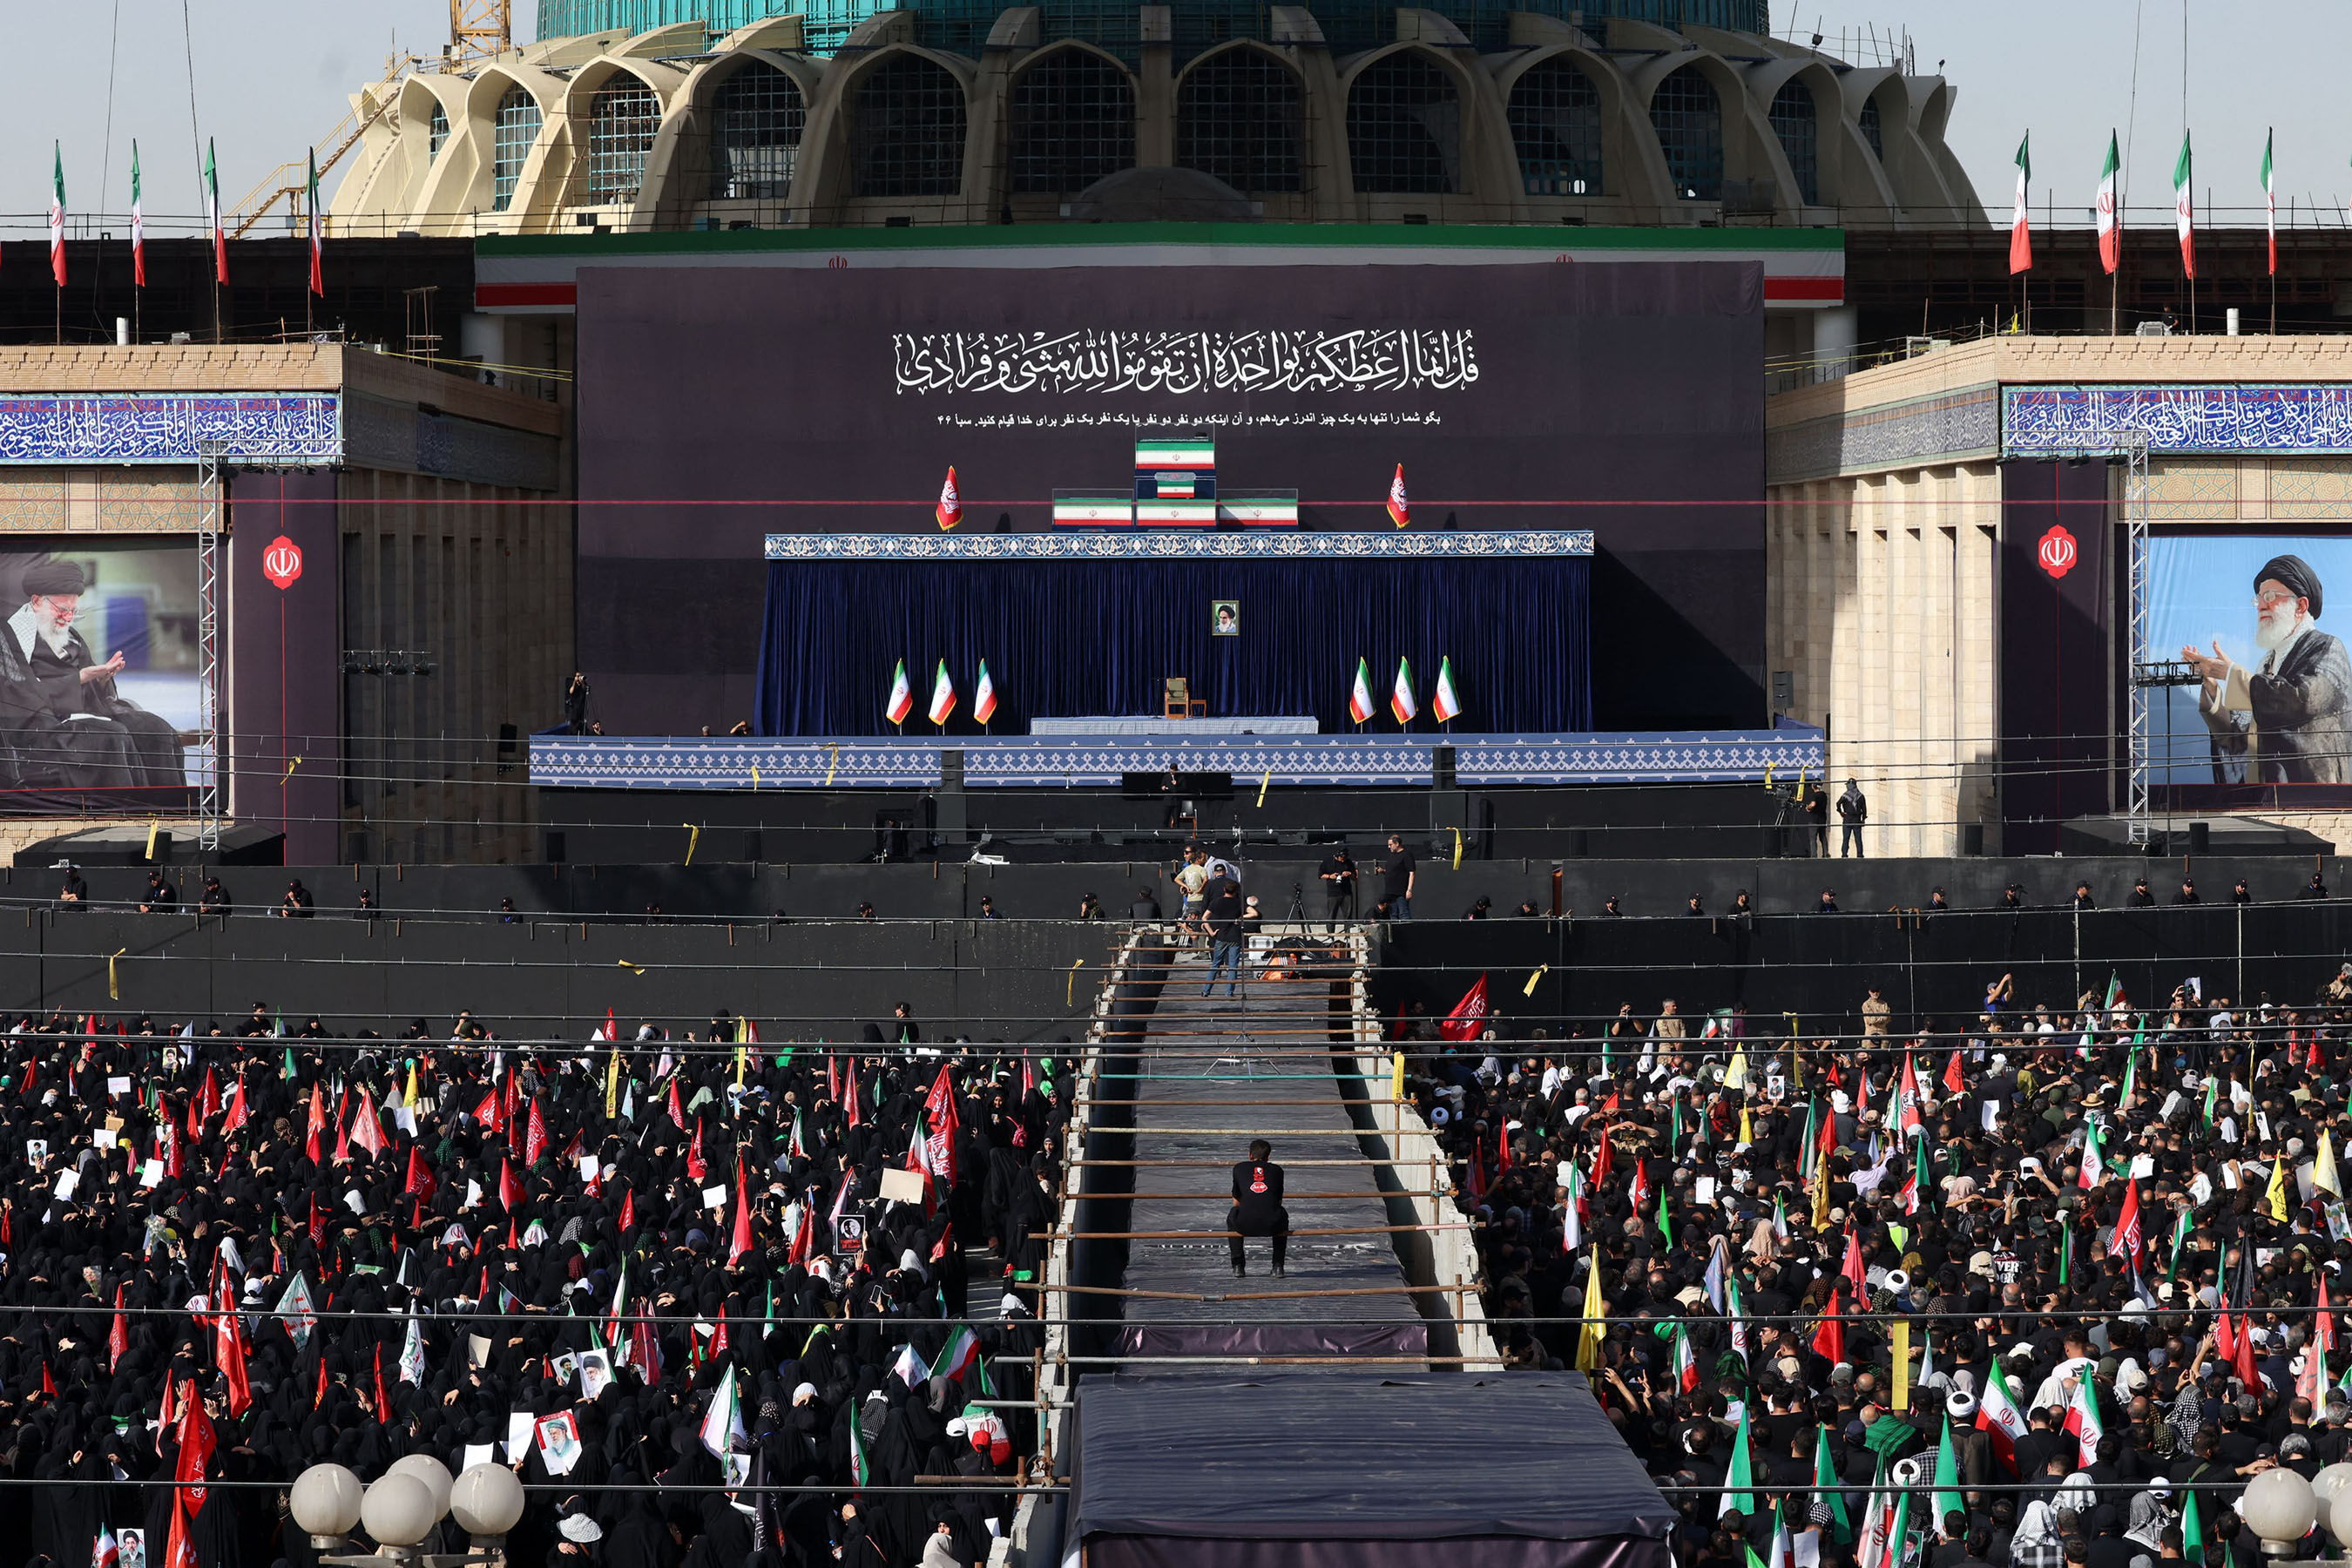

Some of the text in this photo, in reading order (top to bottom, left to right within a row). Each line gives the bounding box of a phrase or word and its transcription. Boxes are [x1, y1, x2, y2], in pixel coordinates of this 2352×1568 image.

[997, 413, 1015, 429] قیام
[1017, 414, 1033, 425] خدا
[1036, 414, 1058, 427] برای
[1059, 413, 1075, 427] نفر
[1077, 413, 1094, 426] یک
[1096, 411, 1112, 425] نفر
[1112, 413, 1130, 426] یک
[1132, 413, 1142, 427] یا
[1144, 413, 1158, 426] نفر
[1159, 416, 1172, 426] دو
[1174, 413, 1189, 427] نفر
[1192, 416, 1203, 426] دو
[1205, 413, 1229, 426] اینکه
[1232, 411, 1243, 426] آن
[1246, 416, 1254, 425] و
[1292, 412, 1316, 425] اندرز
[1318, 413, 1336, 427] چیز
[1338, 413, 1355, 426] یک
[1357, 413, 1368, 425] به
[1369, 412, 1388, 426] تنها
[1390, 412, 1400, 425] را
[1402, 411, 1421, 423] شما
[1423, 410, 1442, 425] بگو
